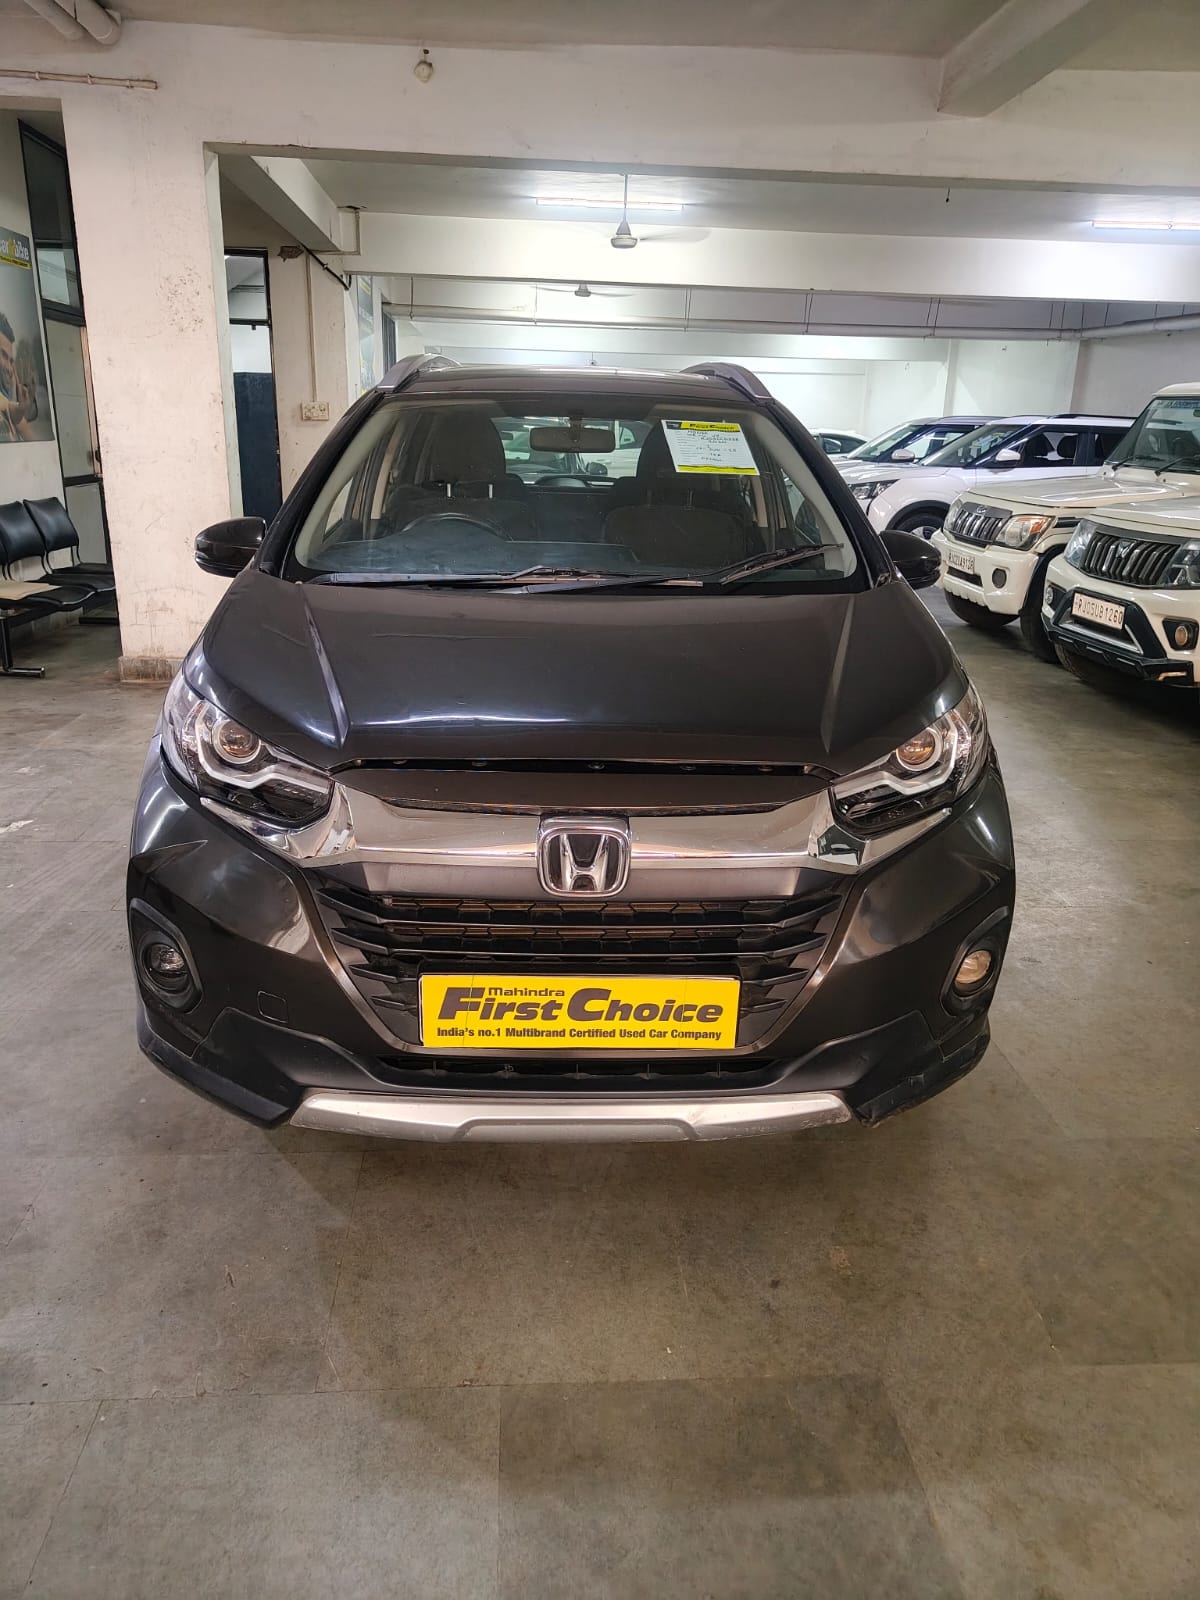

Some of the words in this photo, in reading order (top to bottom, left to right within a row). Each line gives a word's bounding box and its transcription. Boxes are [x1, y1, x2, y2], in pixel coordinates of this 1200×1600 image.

[488, 987, 565, 997] Mahindra
[437, 987, 564, 1021] First
[566, 987, 724, 1023] Choice
[437, 1027, 475, 1037] India's
[477, 1027, 501, 1037] no.1
[505, 1027, 566, 1038] Multibrand
[569, 1028, 616, 1038] Certified
[619, 1029, 646, 1038] Used
[648, 1029, 668, 1039] Car
[670, 1029, 722, 1041] Company
